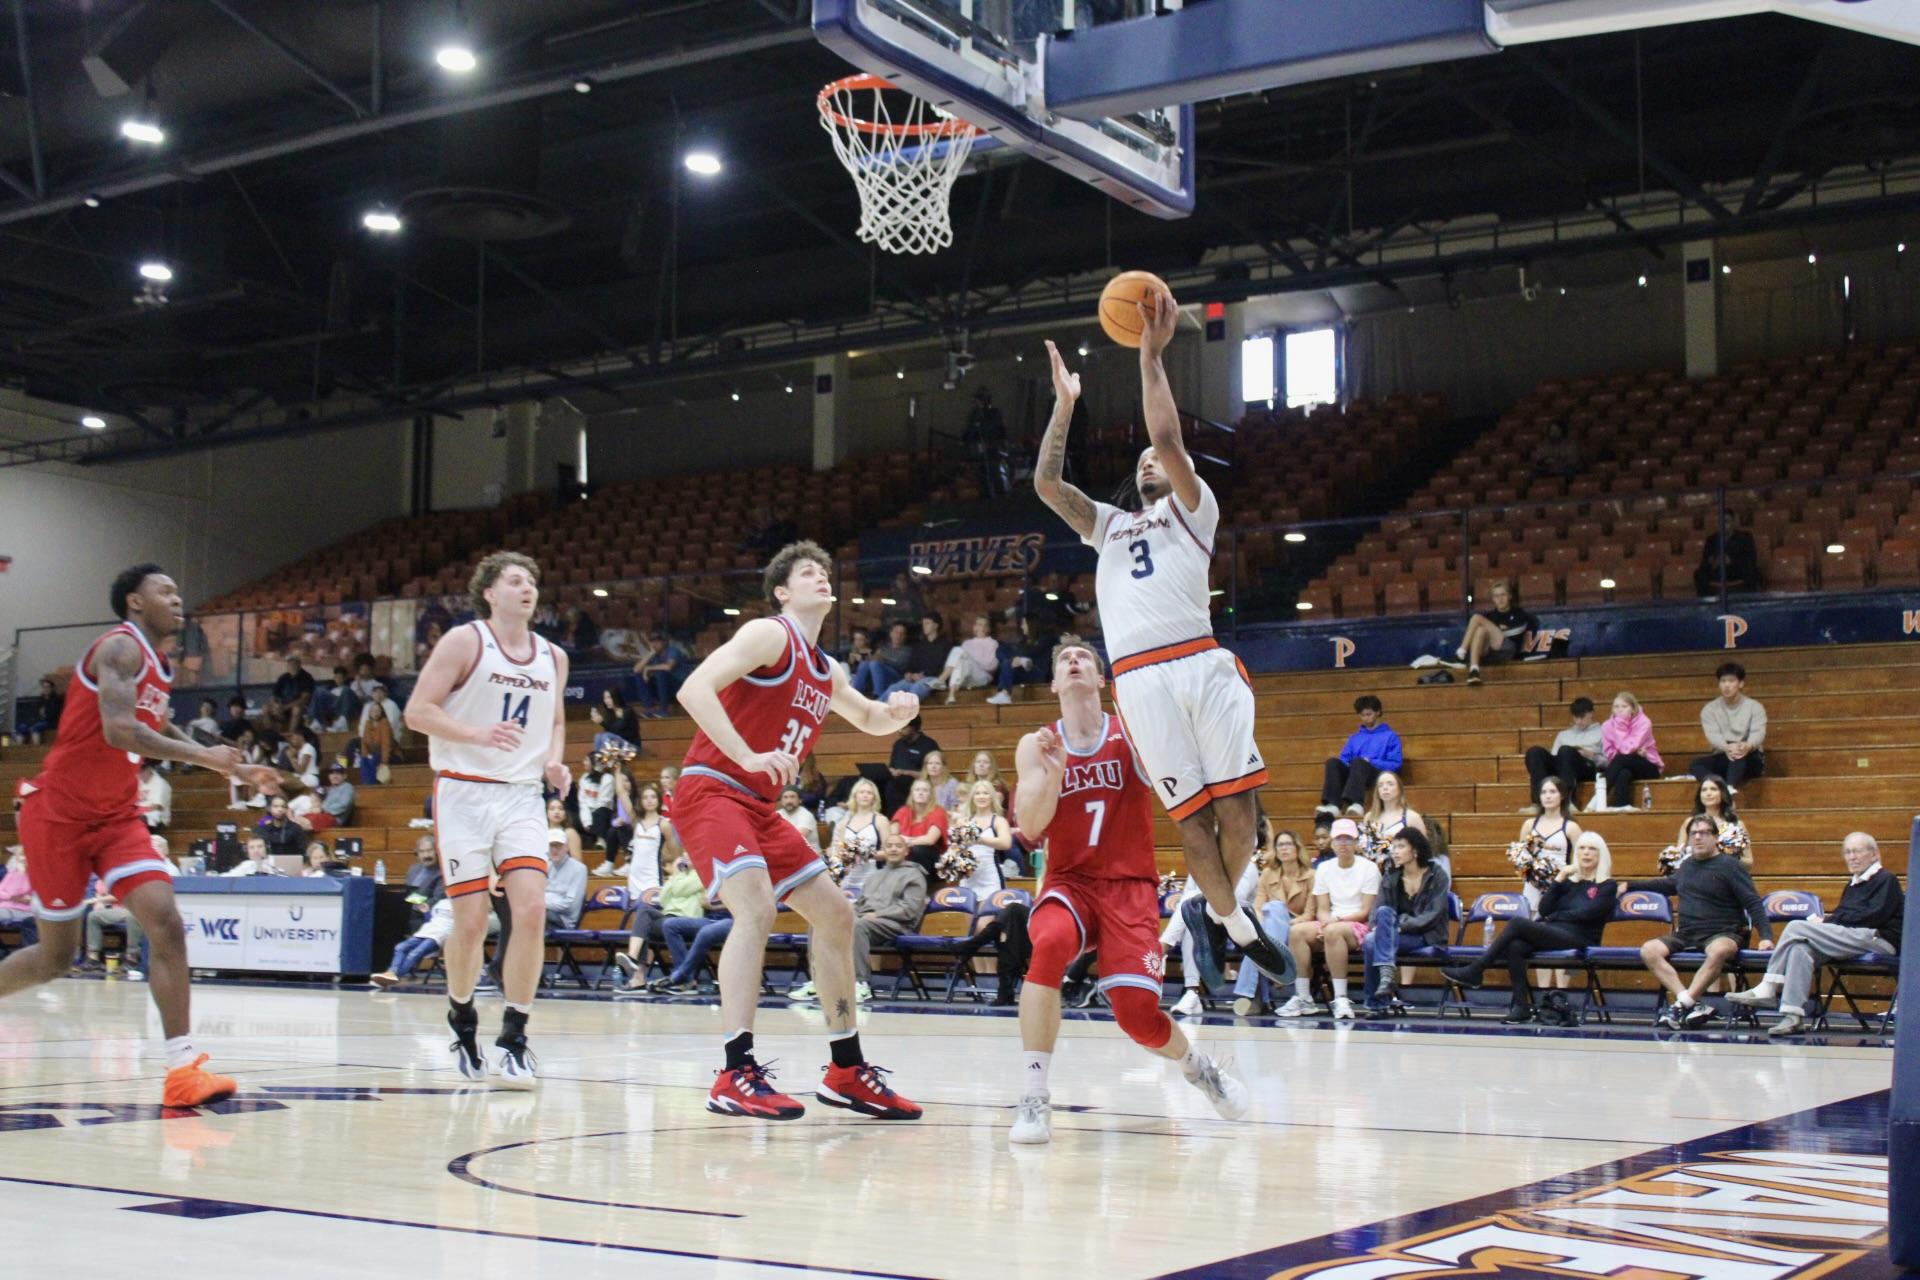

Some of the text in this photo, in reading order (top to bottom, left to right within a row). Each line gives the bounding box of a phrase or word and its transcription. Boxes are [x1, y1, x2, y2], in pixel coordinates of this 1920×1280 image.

[910, 533, 1046, 582] WAVES
[1128, 539, 1155, 580] 3
[1717, 614, 1748, 648] P
[1328, 636, 1356, 668] P
[502, 692, 531, 729] 14
[791, 678, 830, 725] LMU
[775, 718, 813, 758] 35
[1060, 760, 1123, 798] LMU
[1084, 800, 1105, 847] 7
[200, 917, 240, 941] WCC
[253, 925, 338, 942] UNIVERSITY
